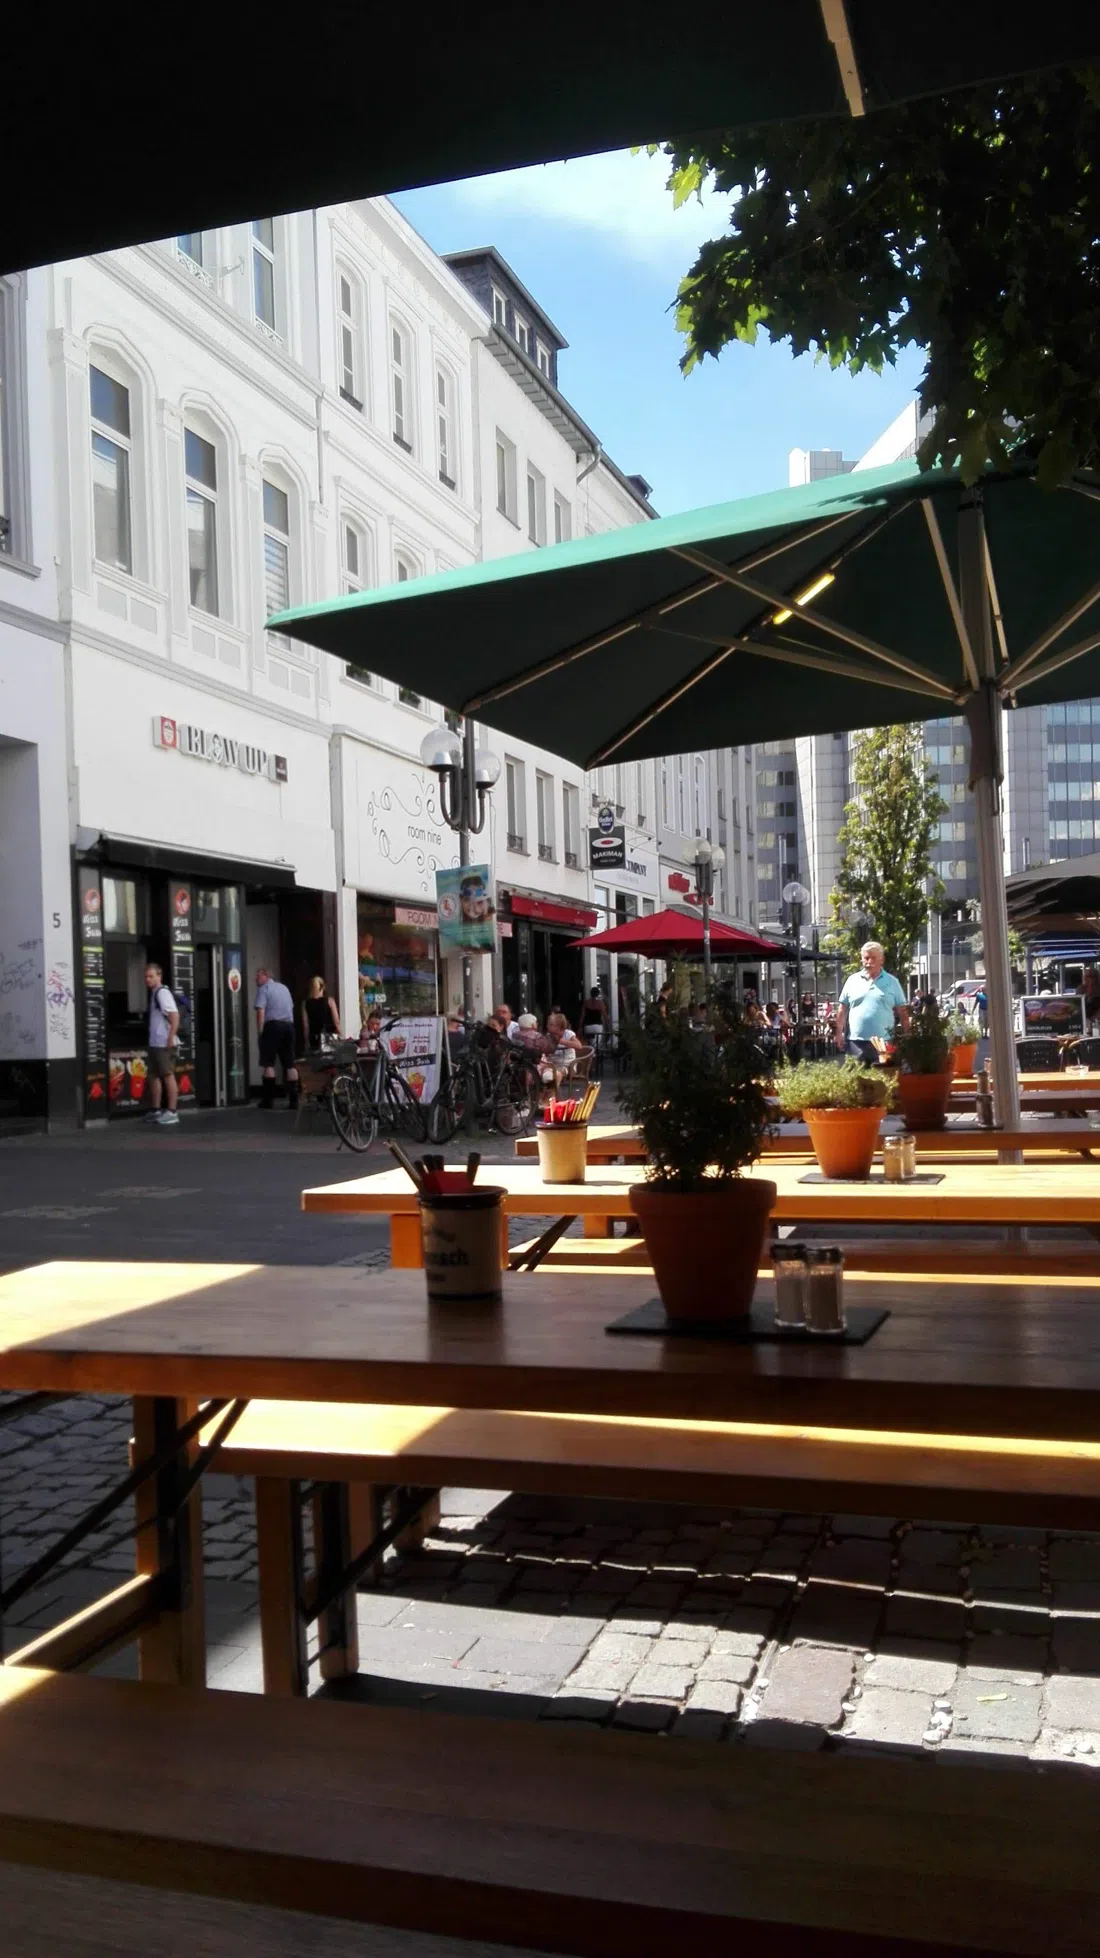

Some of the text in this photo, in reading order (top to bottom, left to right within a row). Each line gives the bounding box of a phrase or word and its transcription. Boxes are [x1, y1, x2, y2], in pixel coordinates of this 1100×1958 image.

[187, 725, 269, 774] BLOW UP
[407, 825, 442, 846] room nine
[53, 912, 61, 929] 5
